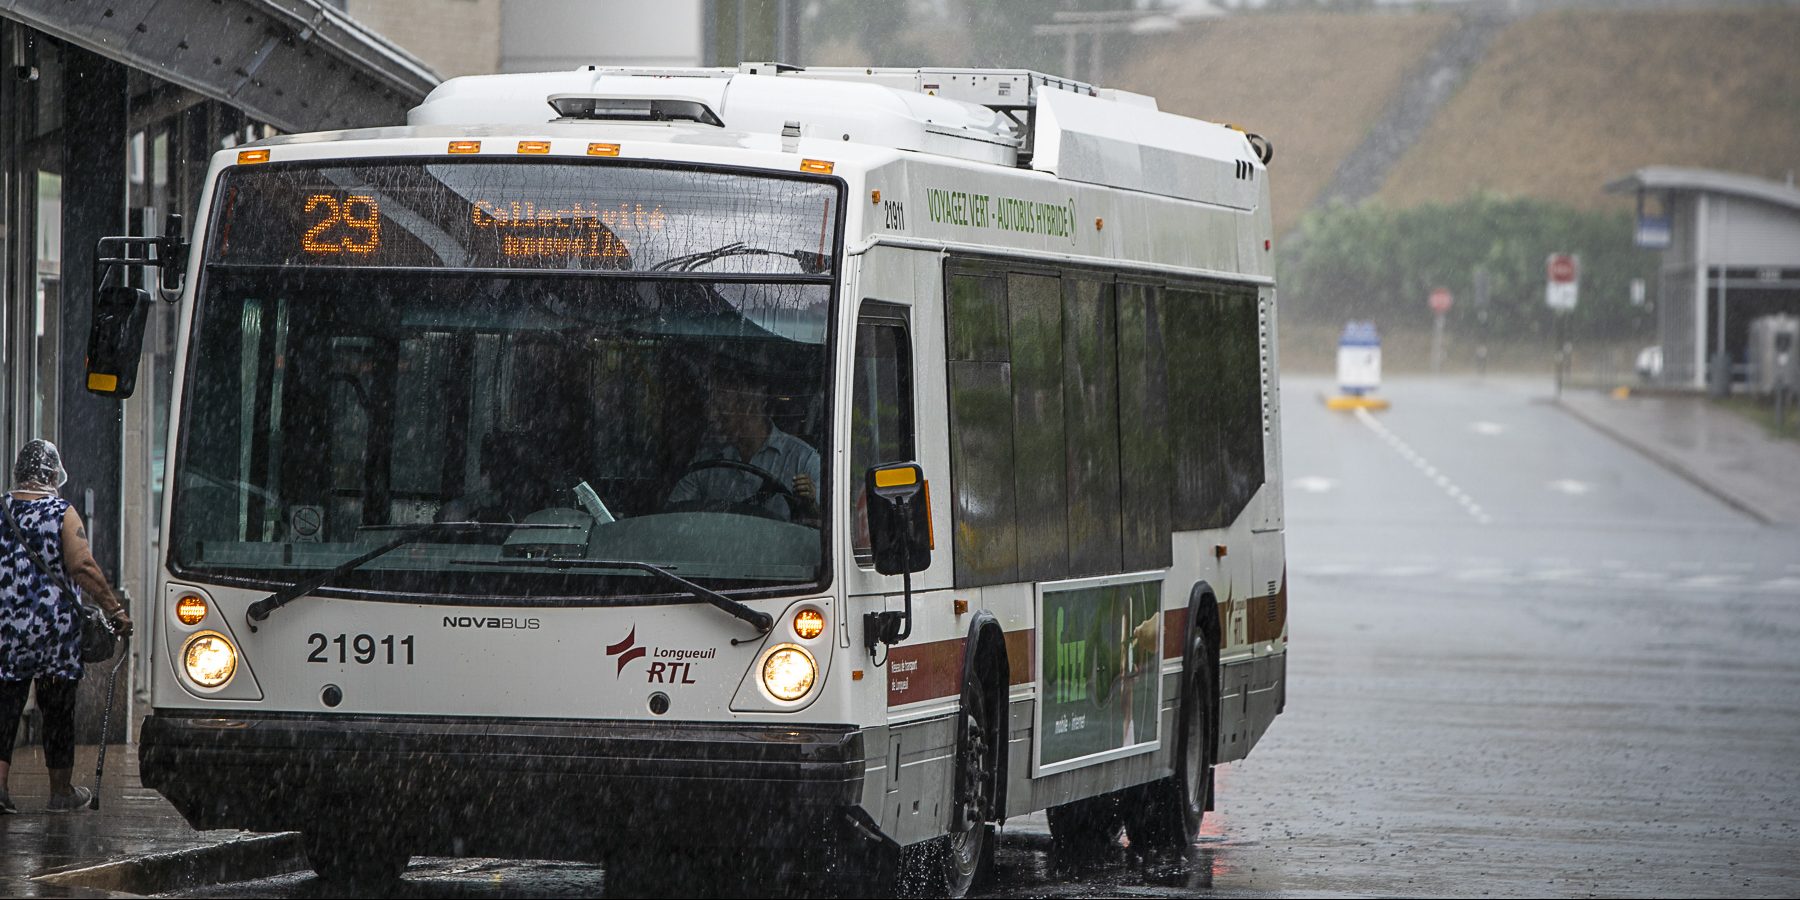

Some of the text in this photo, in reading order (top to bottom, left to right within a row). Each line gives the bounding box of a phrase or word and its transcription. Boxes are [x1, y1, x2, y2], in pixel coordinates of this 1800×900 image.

[303, 195, 380, 253] 29
[473, 200, 666, 229] Collectivité
[884, 200, 905, 230] 21911
[927, 188, 968, 226] VOYAGEZ
[969, 193, 989, 227] VERT
[997, 197, 1034, 233] AUTOBUS
[1036, 202, 1068, 237] HYBRIDE
[307, 632, 414, 665] 21911
[654, 647, 716, 660] Longueuil
[646, 661, 696, 684] RTL
